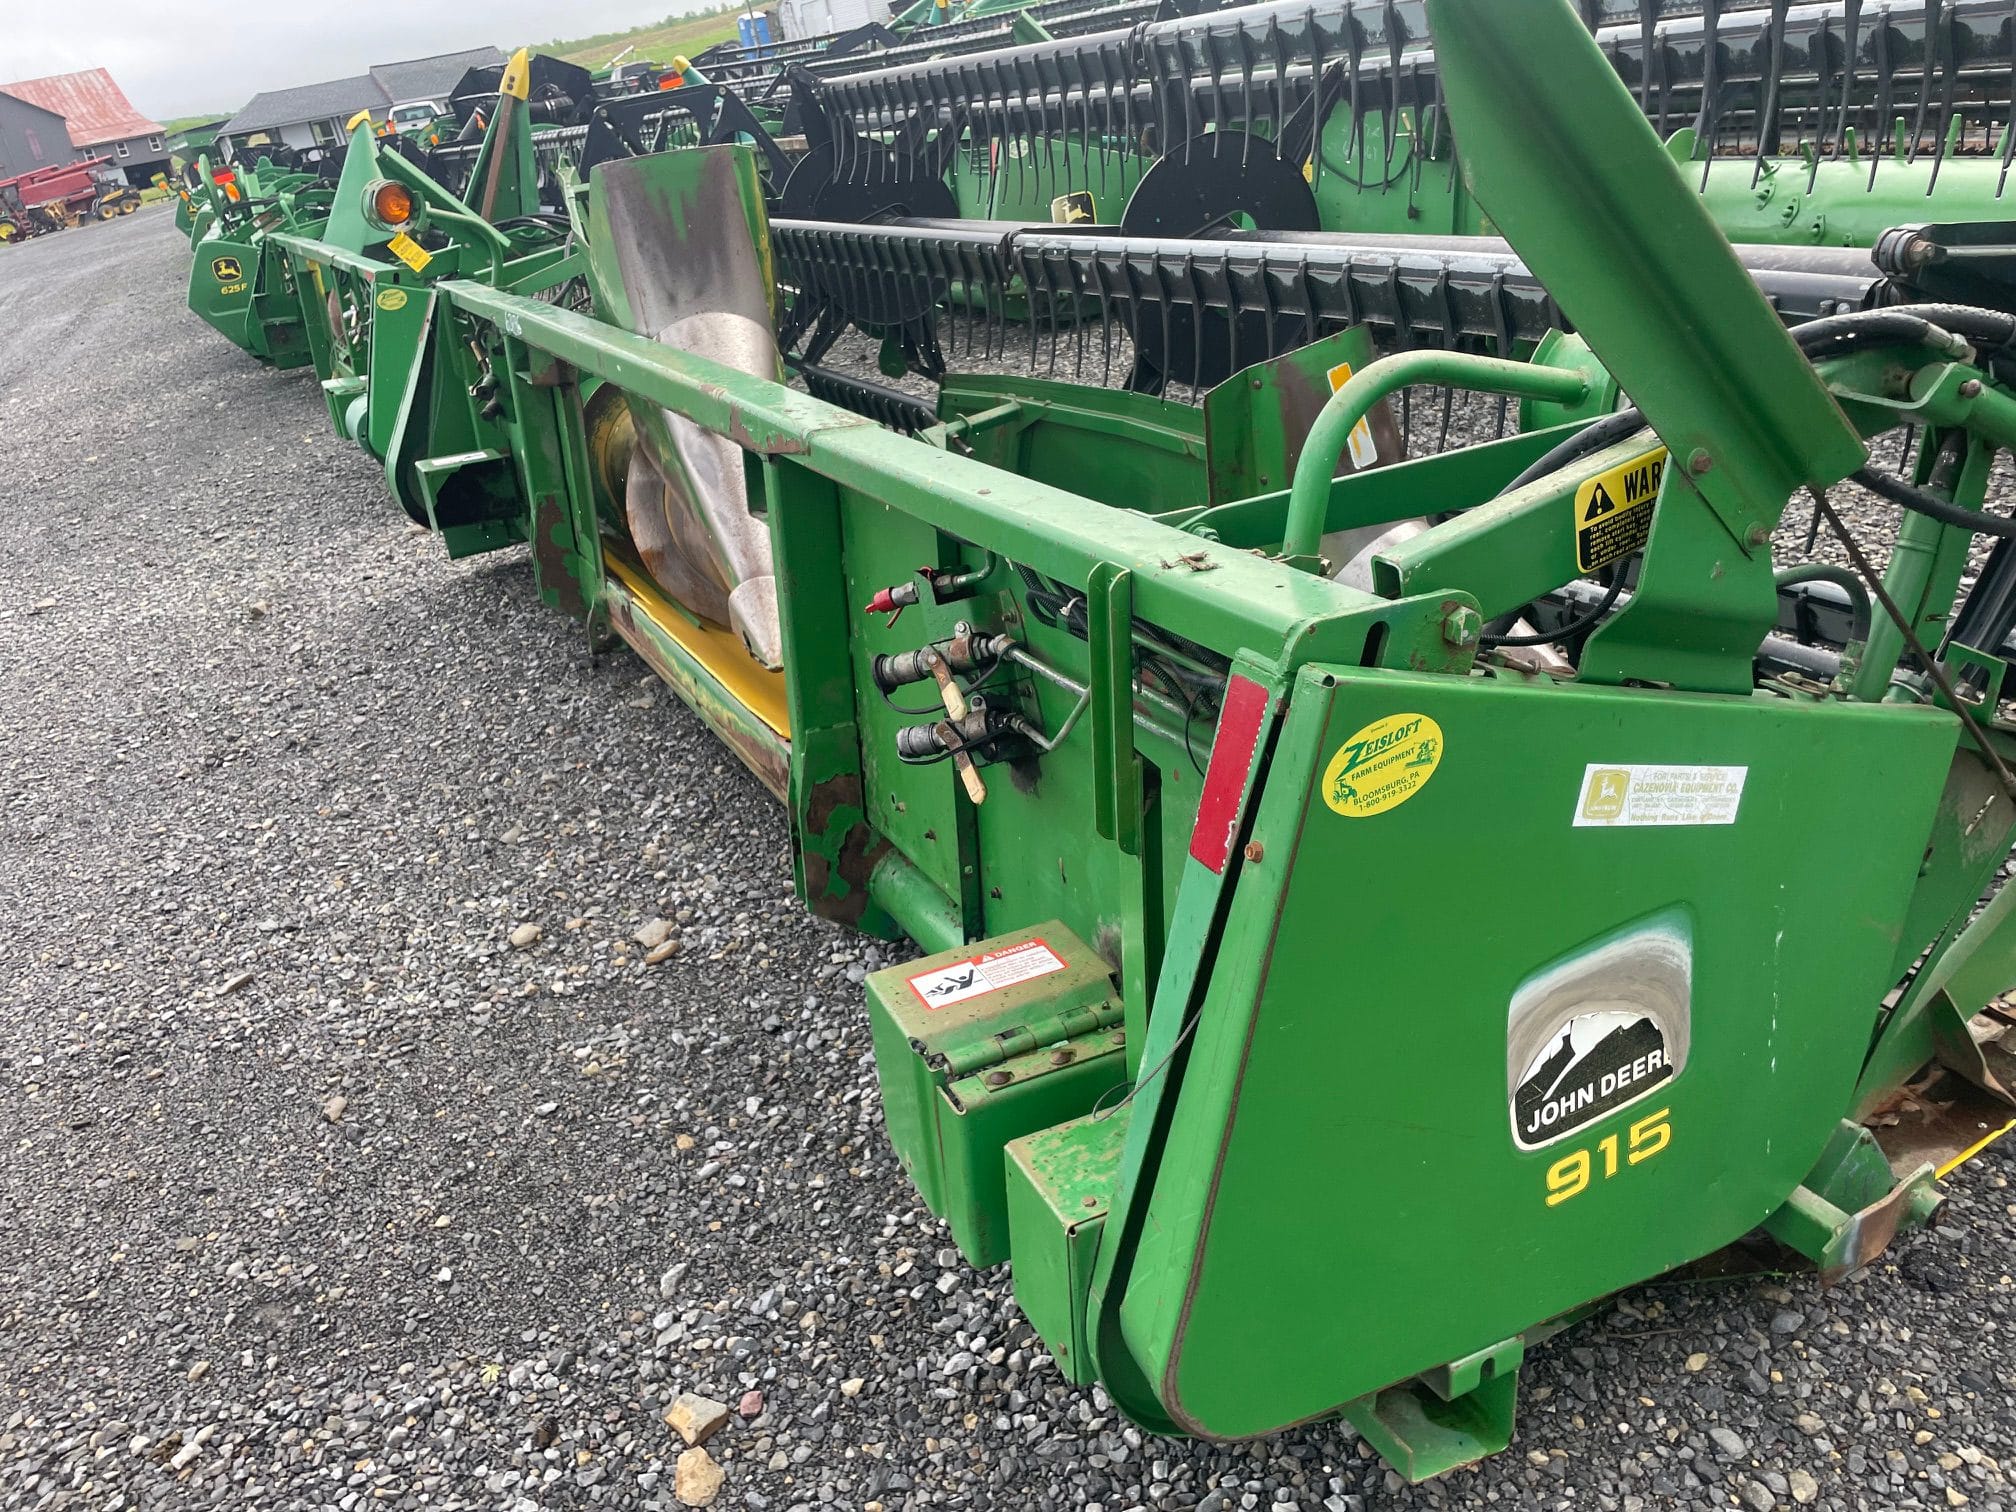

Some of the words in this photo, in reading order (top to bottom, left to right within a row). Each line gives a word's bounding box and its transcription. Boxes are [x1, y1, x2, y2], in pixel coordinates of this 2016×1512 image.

[1335, 718, 1422, 782] ZEISLOFT
[1351, 766, 1374, 781] FARM
[1373, 746, 1416, 772] EQUIPMENT
[1353, 776, 1409, 806] BLOOMSBURG,
[1409, 770, 1420, 780] PA
[1359, 780, 1417, 812] 1-800-919-3322
[1633, 783, 1676, 794] CAZENOVIA
[1680, 783, 1724, 794] EQUIPMENT
[994, 941, 1037, 958] DANGER
[1526, 1082, 1595, 1134] JOHN
[1545, 1107, 1672, 1208] 915
